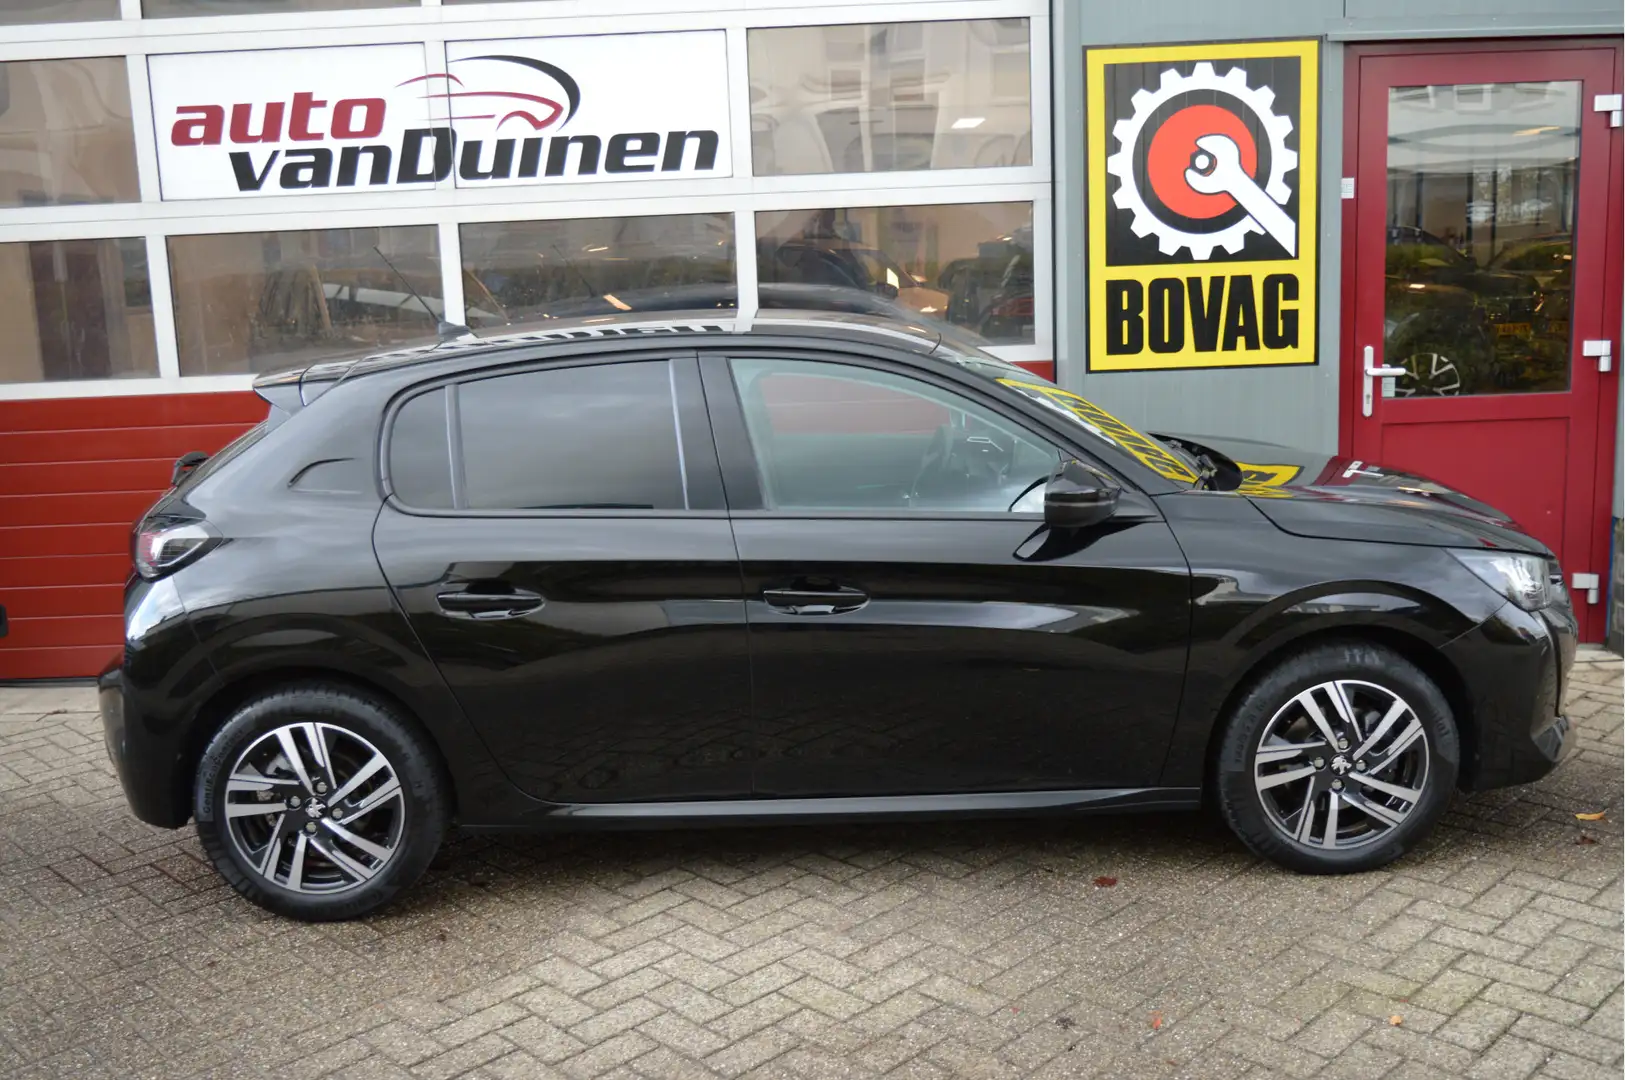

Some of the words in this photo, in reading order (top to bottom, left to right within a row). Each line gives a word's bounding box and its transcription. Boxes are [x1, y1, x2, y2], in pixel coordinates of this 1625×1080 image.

[171, 92, 387, 147] auto
[228, 127, 719, 192] vanDuinen
[1105, 273, 1299, 356] BOVAG
